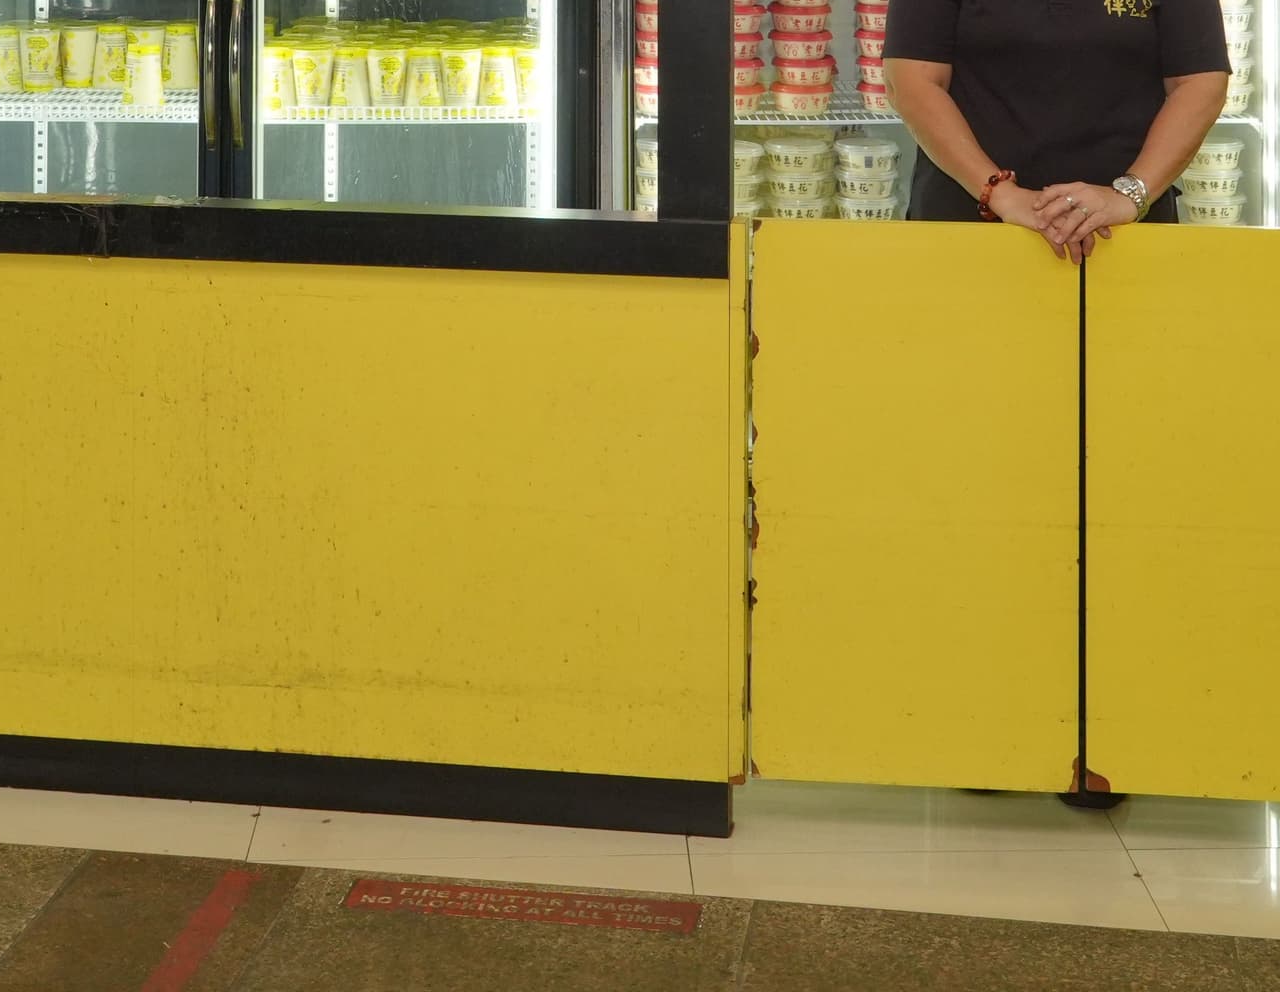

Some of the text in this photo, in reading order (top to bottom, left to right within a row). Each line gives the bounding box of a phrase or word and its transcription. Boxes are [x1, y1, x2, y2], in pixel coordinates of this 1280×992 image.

[360, 894, 394, 905] NO
[525, 907, 555, 916] AT
[563, 910, 604, 920] ALL
[614, 912, 682, 926] TIMES
[399, 887, 650, 913] FIRE SHUTTER TRACK
